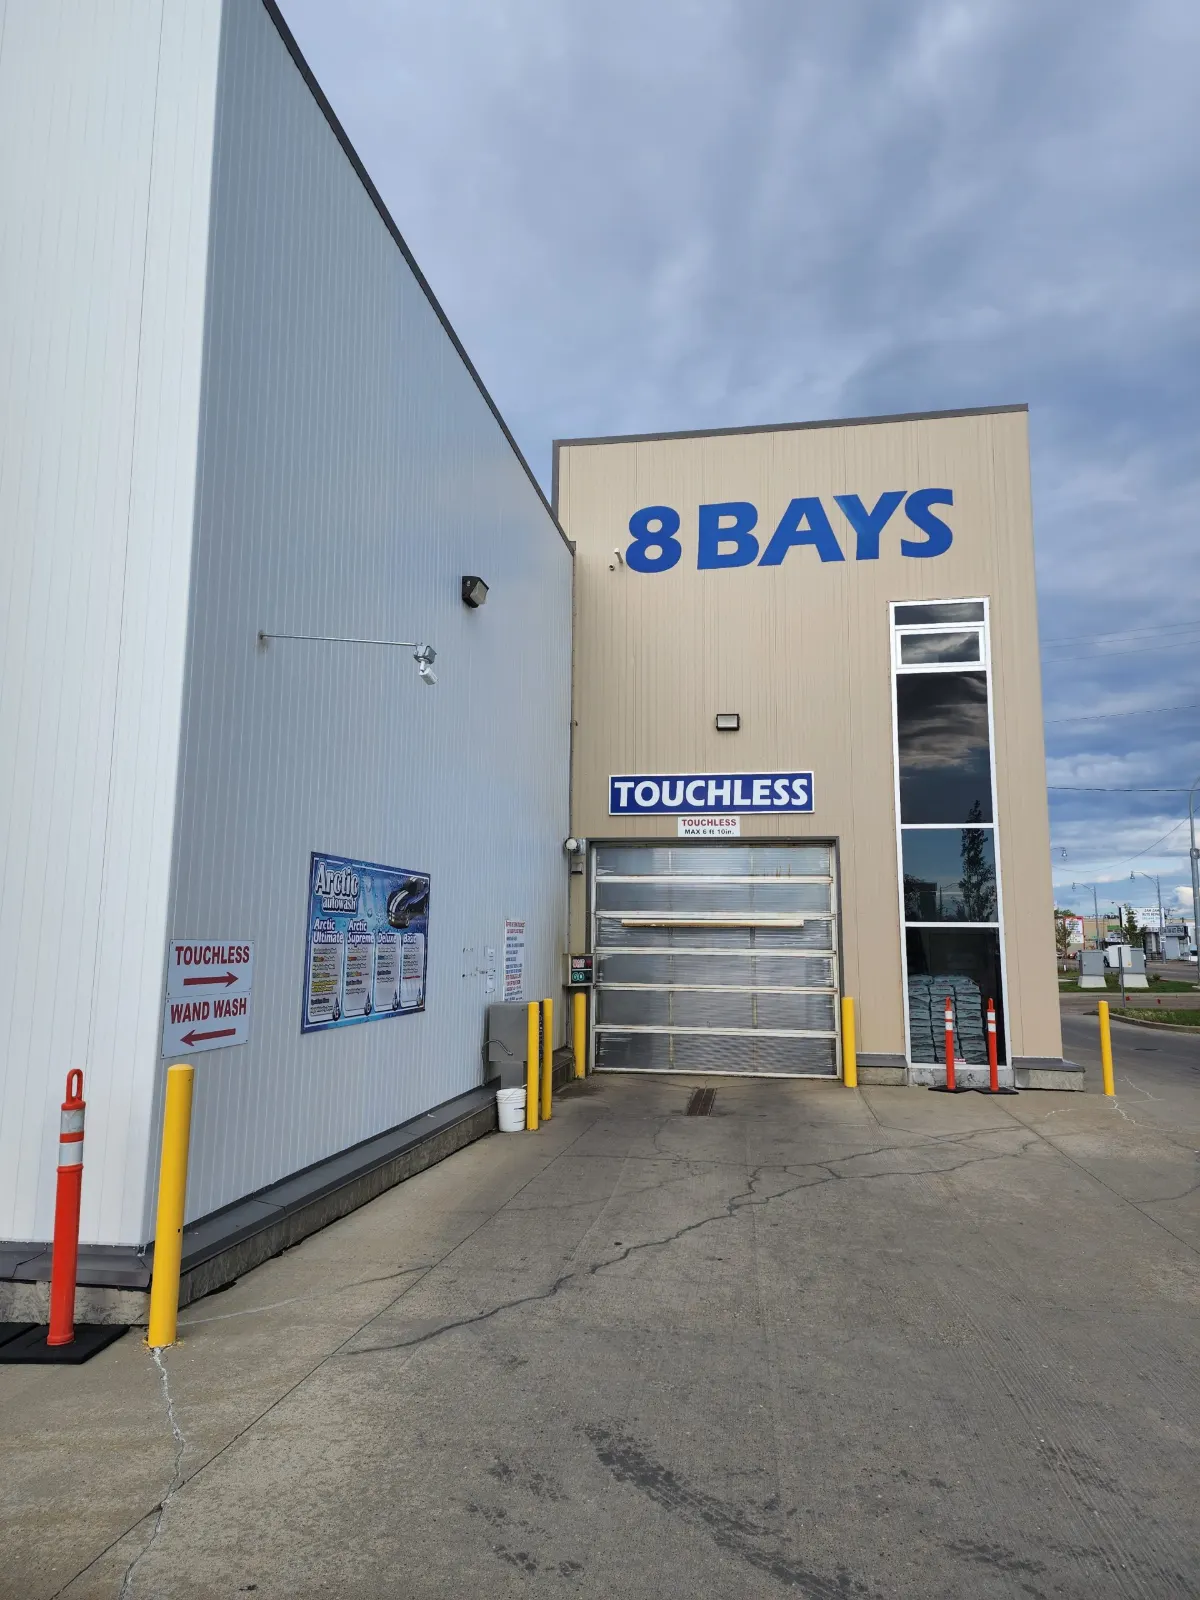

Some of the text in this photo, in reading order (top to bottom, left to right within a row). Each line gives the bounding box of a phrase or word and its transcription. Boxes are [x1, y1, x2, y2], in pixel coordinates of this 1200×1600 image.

[625, 488, 954, 574] 8 BAYS
[614, 778, 808, 808] TOUCHLESS
[681, 818, 737, 827] TOUCHLESS
[315, 862, 359, 897] Arctic
[322, 896, 357, 912] autowash
[313, 918, 336, 931] Arctic
[348, 919, 368, 931] Arctic
[312, 930, 344, 944] Ultimate
[347, 931, 375, 947] Supreme
[377, 931, 397, 944] Deluxe
[403, 932, 417, 944] Basic
[175, 945, 250, 966] TOUCHLESS
[572, 971, 584, 981] GO
[170, 997, 247, 1024] WAND WASH
